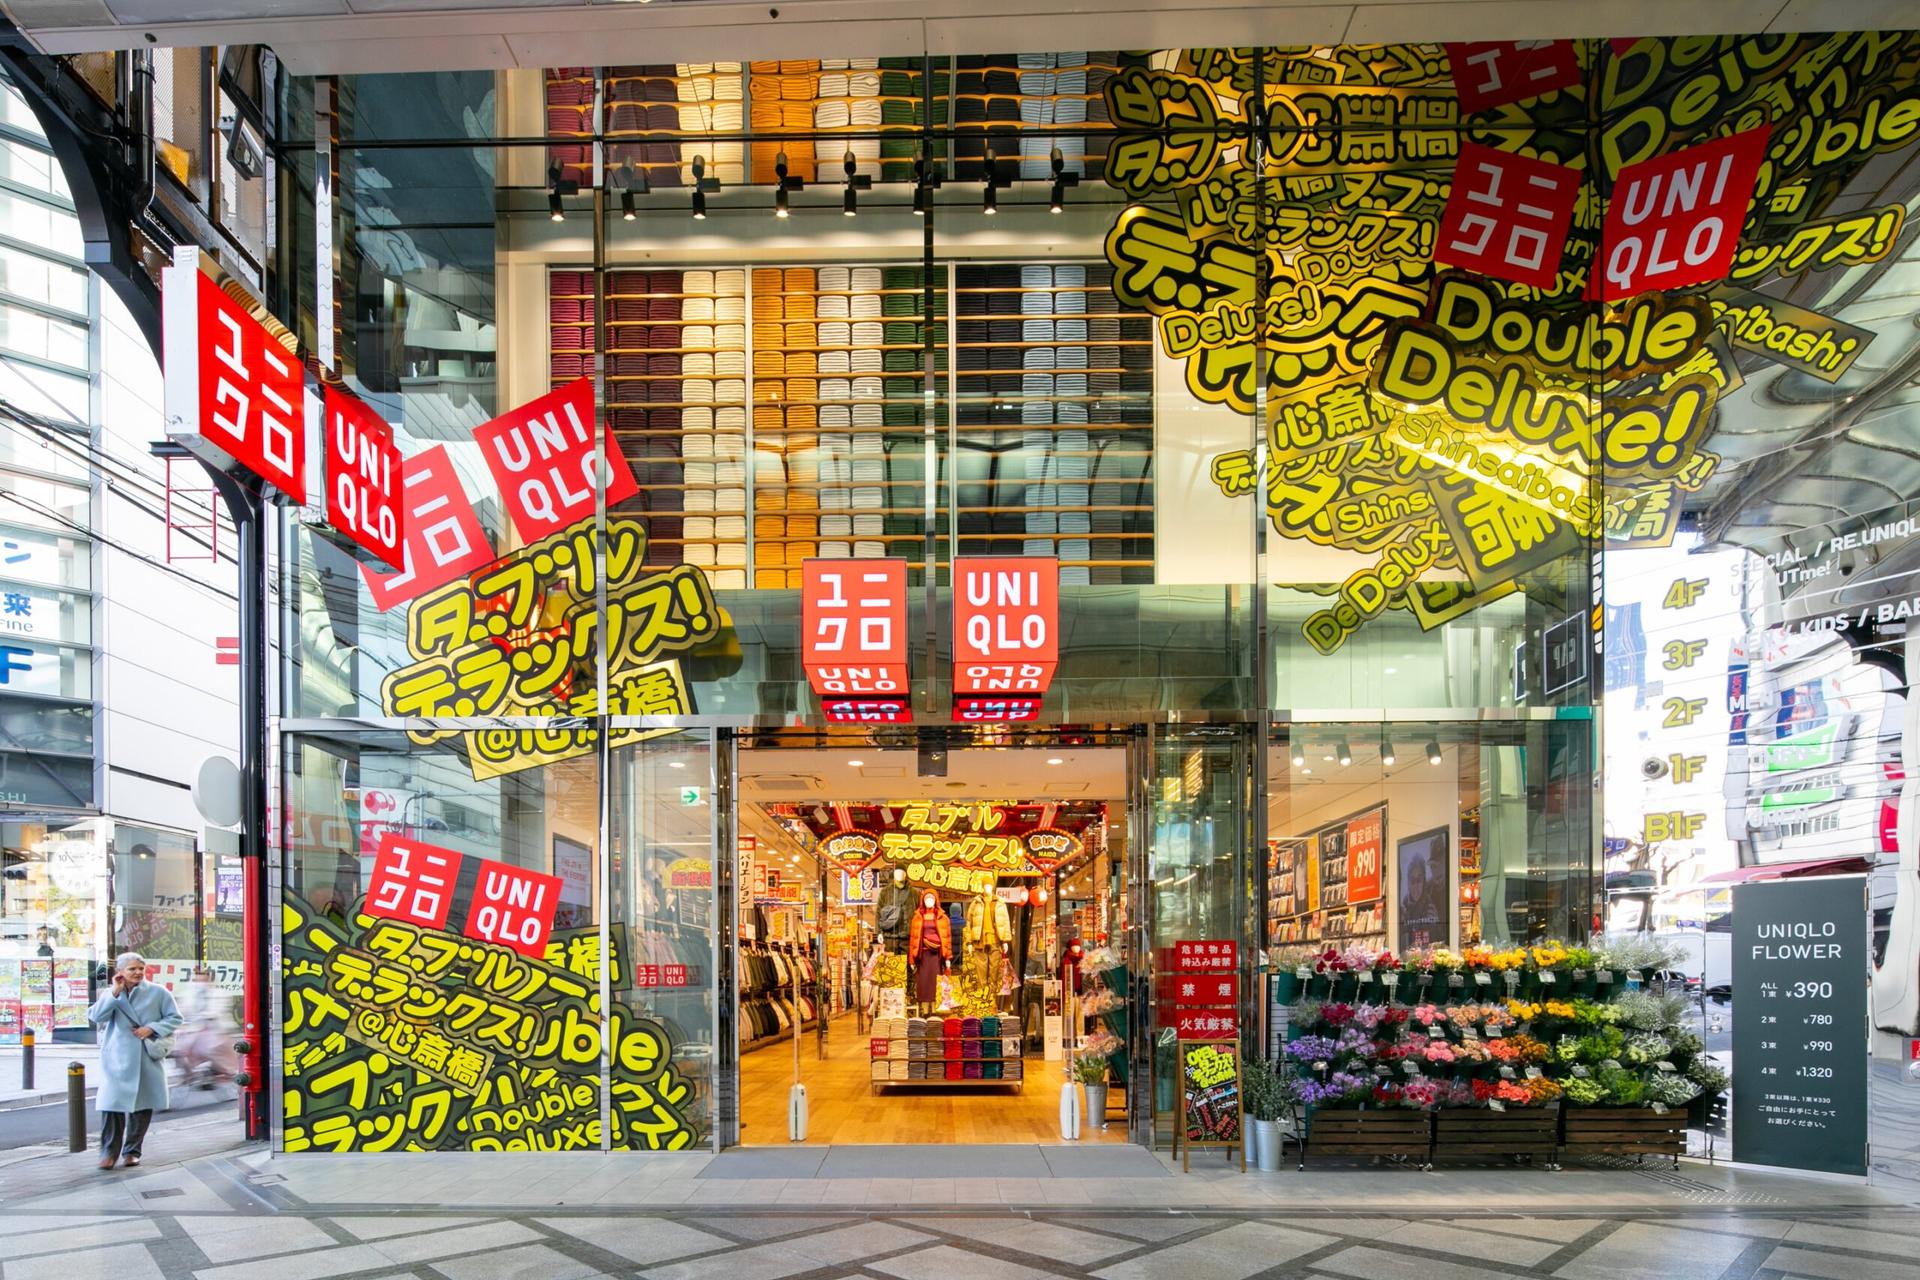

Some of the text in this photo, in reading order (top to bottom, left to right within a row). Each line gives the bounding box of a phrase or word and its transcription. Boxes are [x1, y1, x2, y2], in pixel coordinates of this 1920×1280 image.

[1466, 161, 1558, 220] ユニ
[1622, 154, 1735, 226] UNI
[1450, 213, 1549, 271] クロ
[1606, 216, 1726, 289] QLO
[1437, 280, 1697, 371] Double
[215, 308, 293, 413] ユニ
[1384, 330, 1701, 463] Deluxe!
[213, 381, 293, 478] クロ
[494, 401, 588, 472] UNI
[335, 411, 391, 496] UNI
[518, 449, 616, 523] QLO
[337, 472, 397, 549] QLO
[817, 573, 891, 607] ユニ
[967, 572, 1038, 606] UNI
[1662, 578, 1709, 609] 4F
[814, 617, 891, 651] クロ
[967, 614, 1046, 655] QLO
[1796, 613, 1850, 635] KIDS
[1662, 639, 1708, 670] 3F
[817, 667, 888, 679] UNI
[823, 680, 897, 692] QLO
[1662, 698, 1708, 729] 2F
[1668, 753, 1707, 784] 1F
[1644, 811, 1707, 843] B1F
[881, 833, 1019, 864] デラックス!
[1354, 848, 1376, 878] ¥990
[384, 846, 447, 888] ユニ
[374, 883, 442, 921] クロ
[485, 871, 546, 911] UNI
[476, 906, 542, 946] QLO
[1757, 922, 1835, 939] UNIQLO
[367, 928, 523, 991] ダブル
[1181, 945, 1232, 955] 危険物品
[1752, 944, 1842, 960] FLOWER
[639, 967, 657, 975] ユニ
[666, 967, 683, 975] UNI
[666, 976, 685, 984] QLO
[331, 953, 538, 1052] デラックス!
[1785, 982, 1832, 999] ¥390
[1180, 1017, 1235, 1031] 火気厳禁
[1803, 1014, 1832, 1025] ¥780
[357, 1009, 487, 1088] @心斎橋
[1803, 1040, 1832, 1052] ¥990
